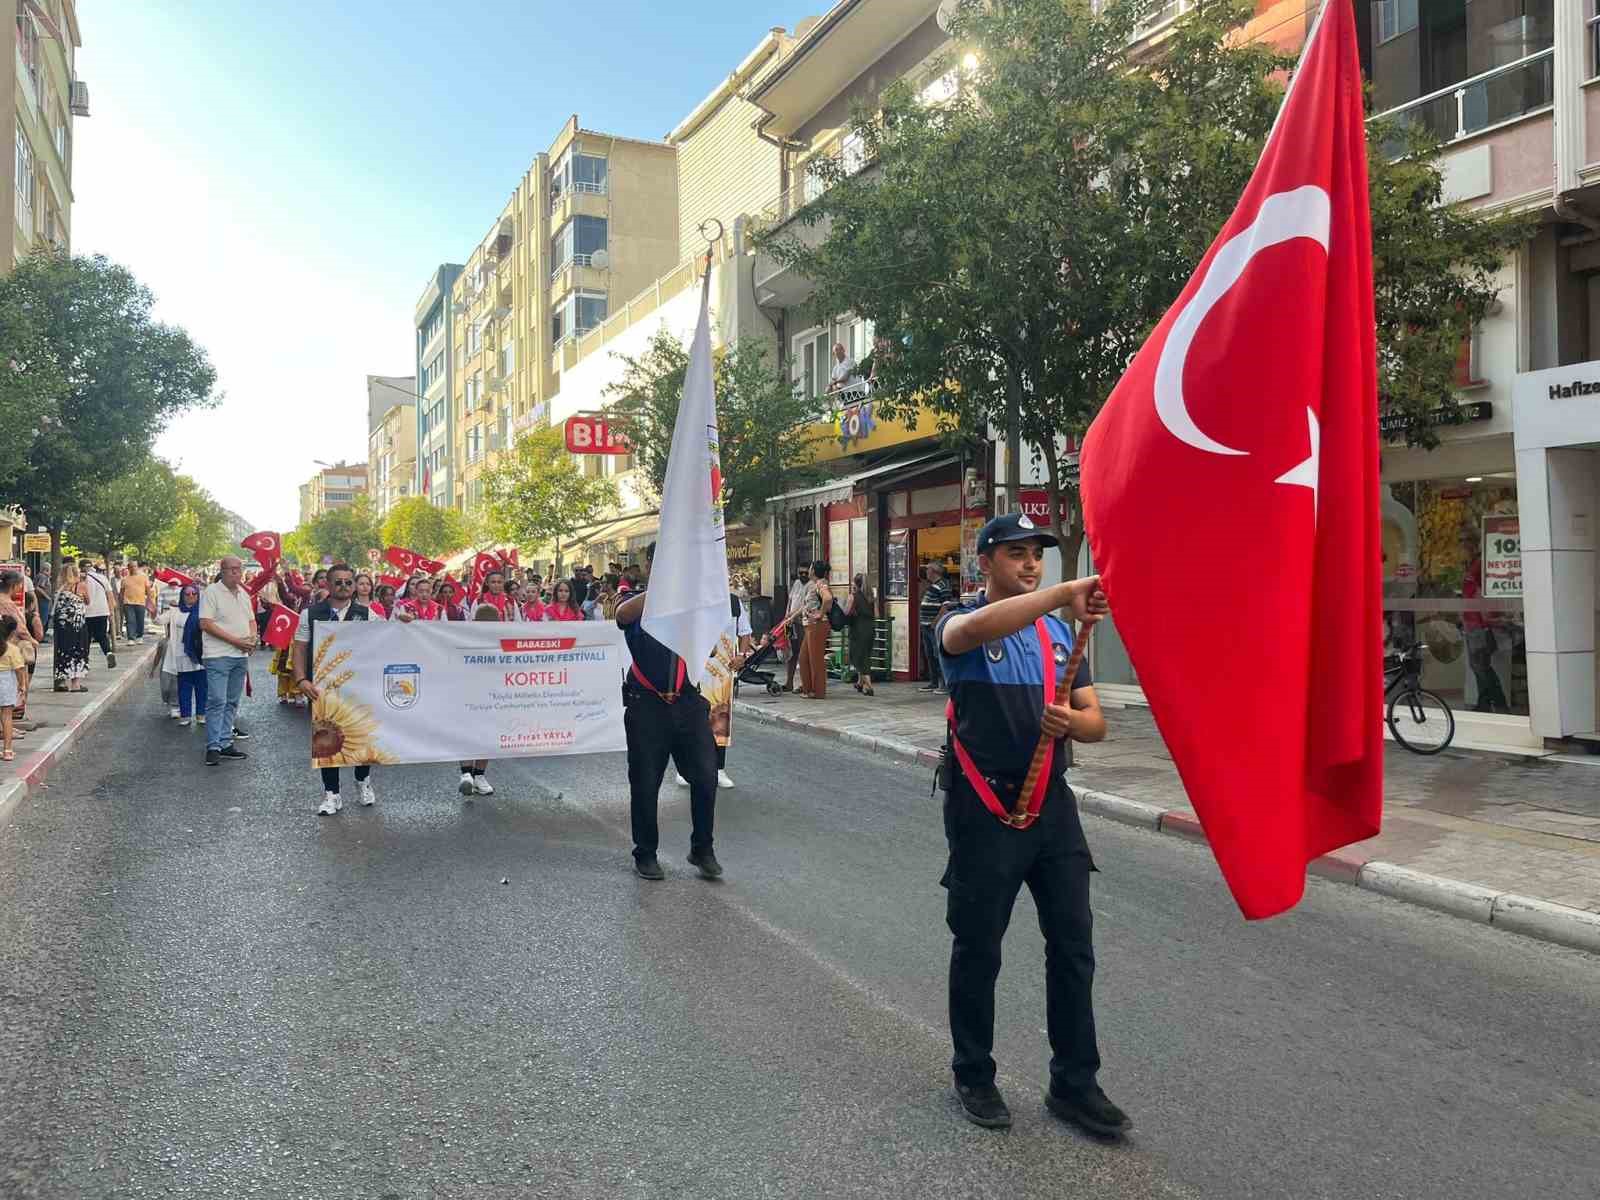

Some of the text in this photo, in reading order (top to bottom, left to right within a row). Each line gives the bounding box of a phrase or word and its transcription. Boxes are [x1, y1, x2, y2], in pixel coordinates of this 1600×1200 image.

[1548, 380, 1600, 400] Hafize
[464, 655, 496, 665] TARIM
[499, 654, 512, 664] VE
[557, 650, 606, 662] FESTİVALİ
[505, 667, 568, 686] KORTEJİ
[543, 730, 574, 741] YAYLA
